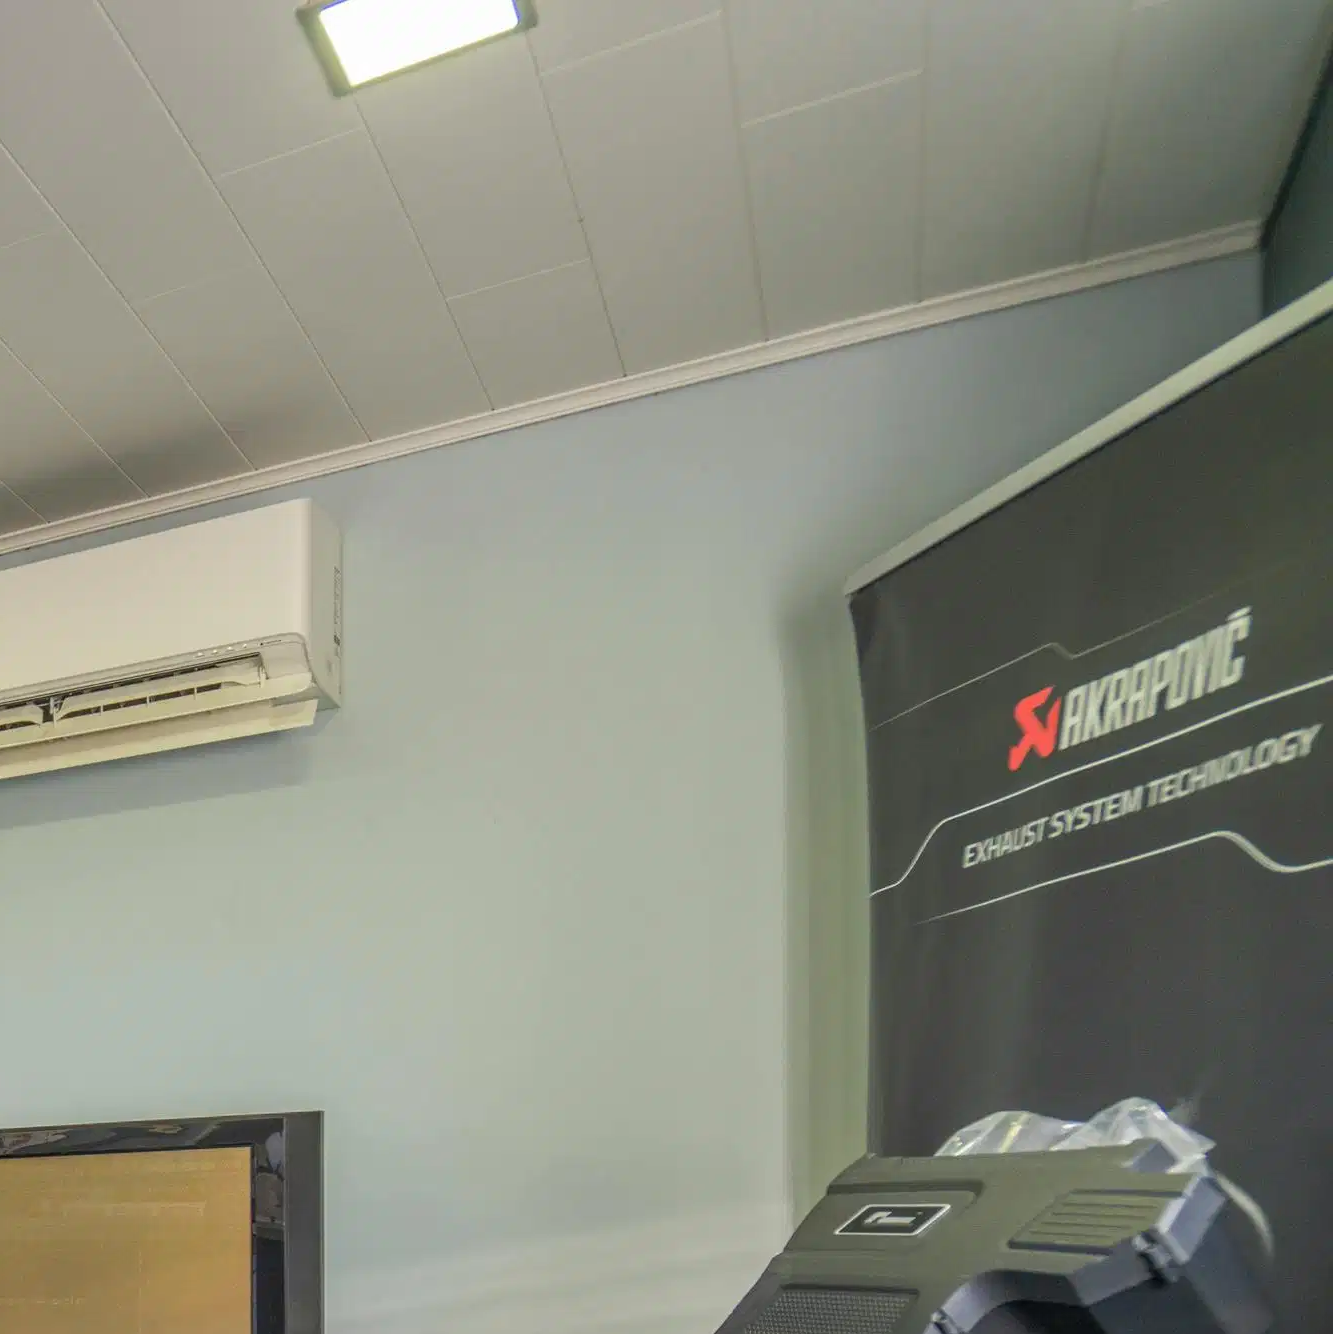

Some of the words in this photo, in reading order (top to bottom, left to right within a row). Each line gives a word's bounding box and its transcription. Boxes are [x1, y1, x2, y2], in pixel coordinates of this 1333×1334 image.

[960, 816, 1049, 870] EXHAUST
[1047, 784, 1145, 840] SYSTEM
[1146, 722, 1325, 809] TECHNOLOGY
